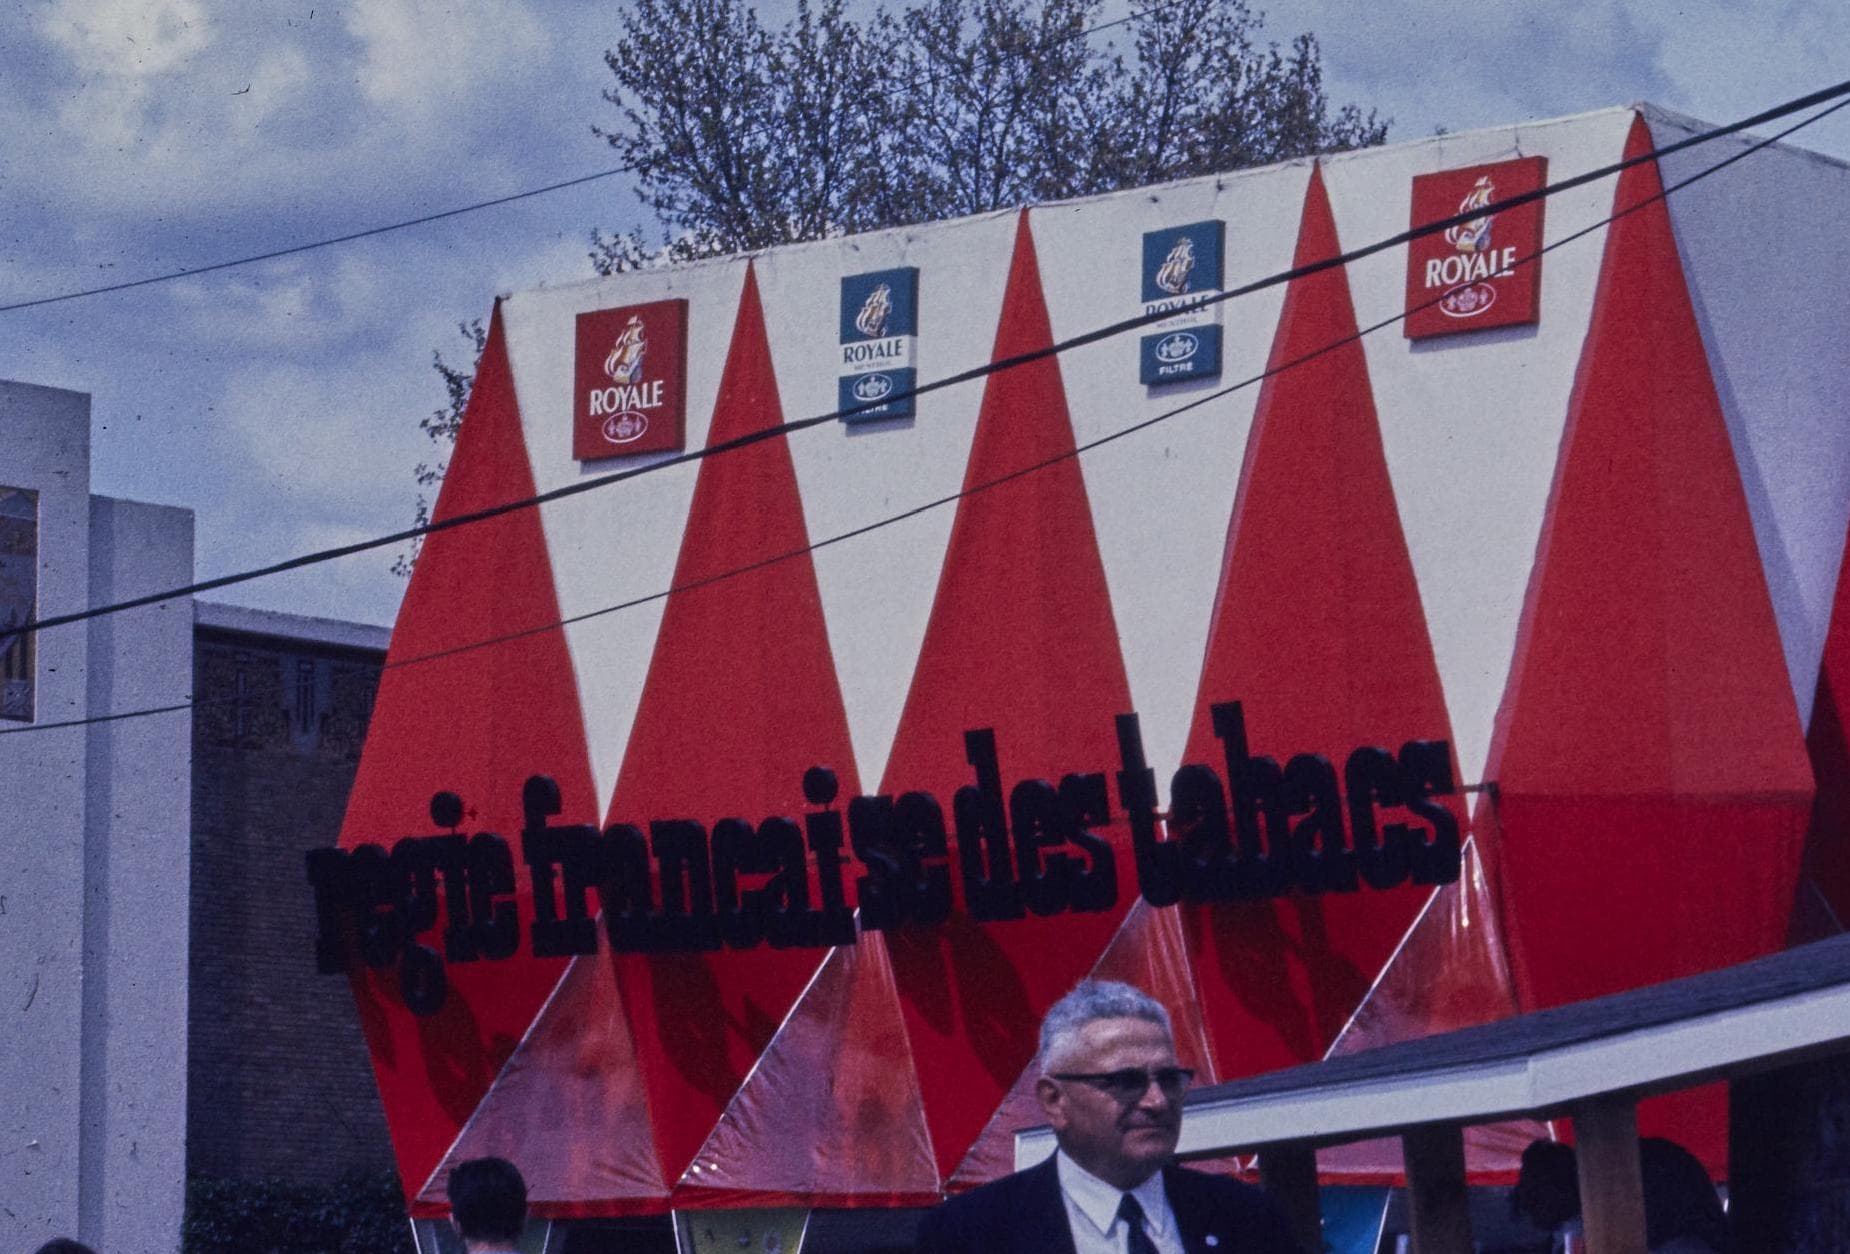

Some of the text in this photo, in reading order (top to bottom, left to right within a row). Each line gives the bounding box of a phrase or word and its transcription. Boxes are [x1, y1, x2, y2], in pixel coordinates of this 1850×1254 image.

[1425, 246, 1516, 289] ROYALE
[843, 338, 903, 364] ROYALE
[1158, 361, 1195, 376] FILTRE
[589, 380, 664, 416] ROYALE
[953, 727, 1118, 923] des
[1114, 700, 1461, 908] tabacs
